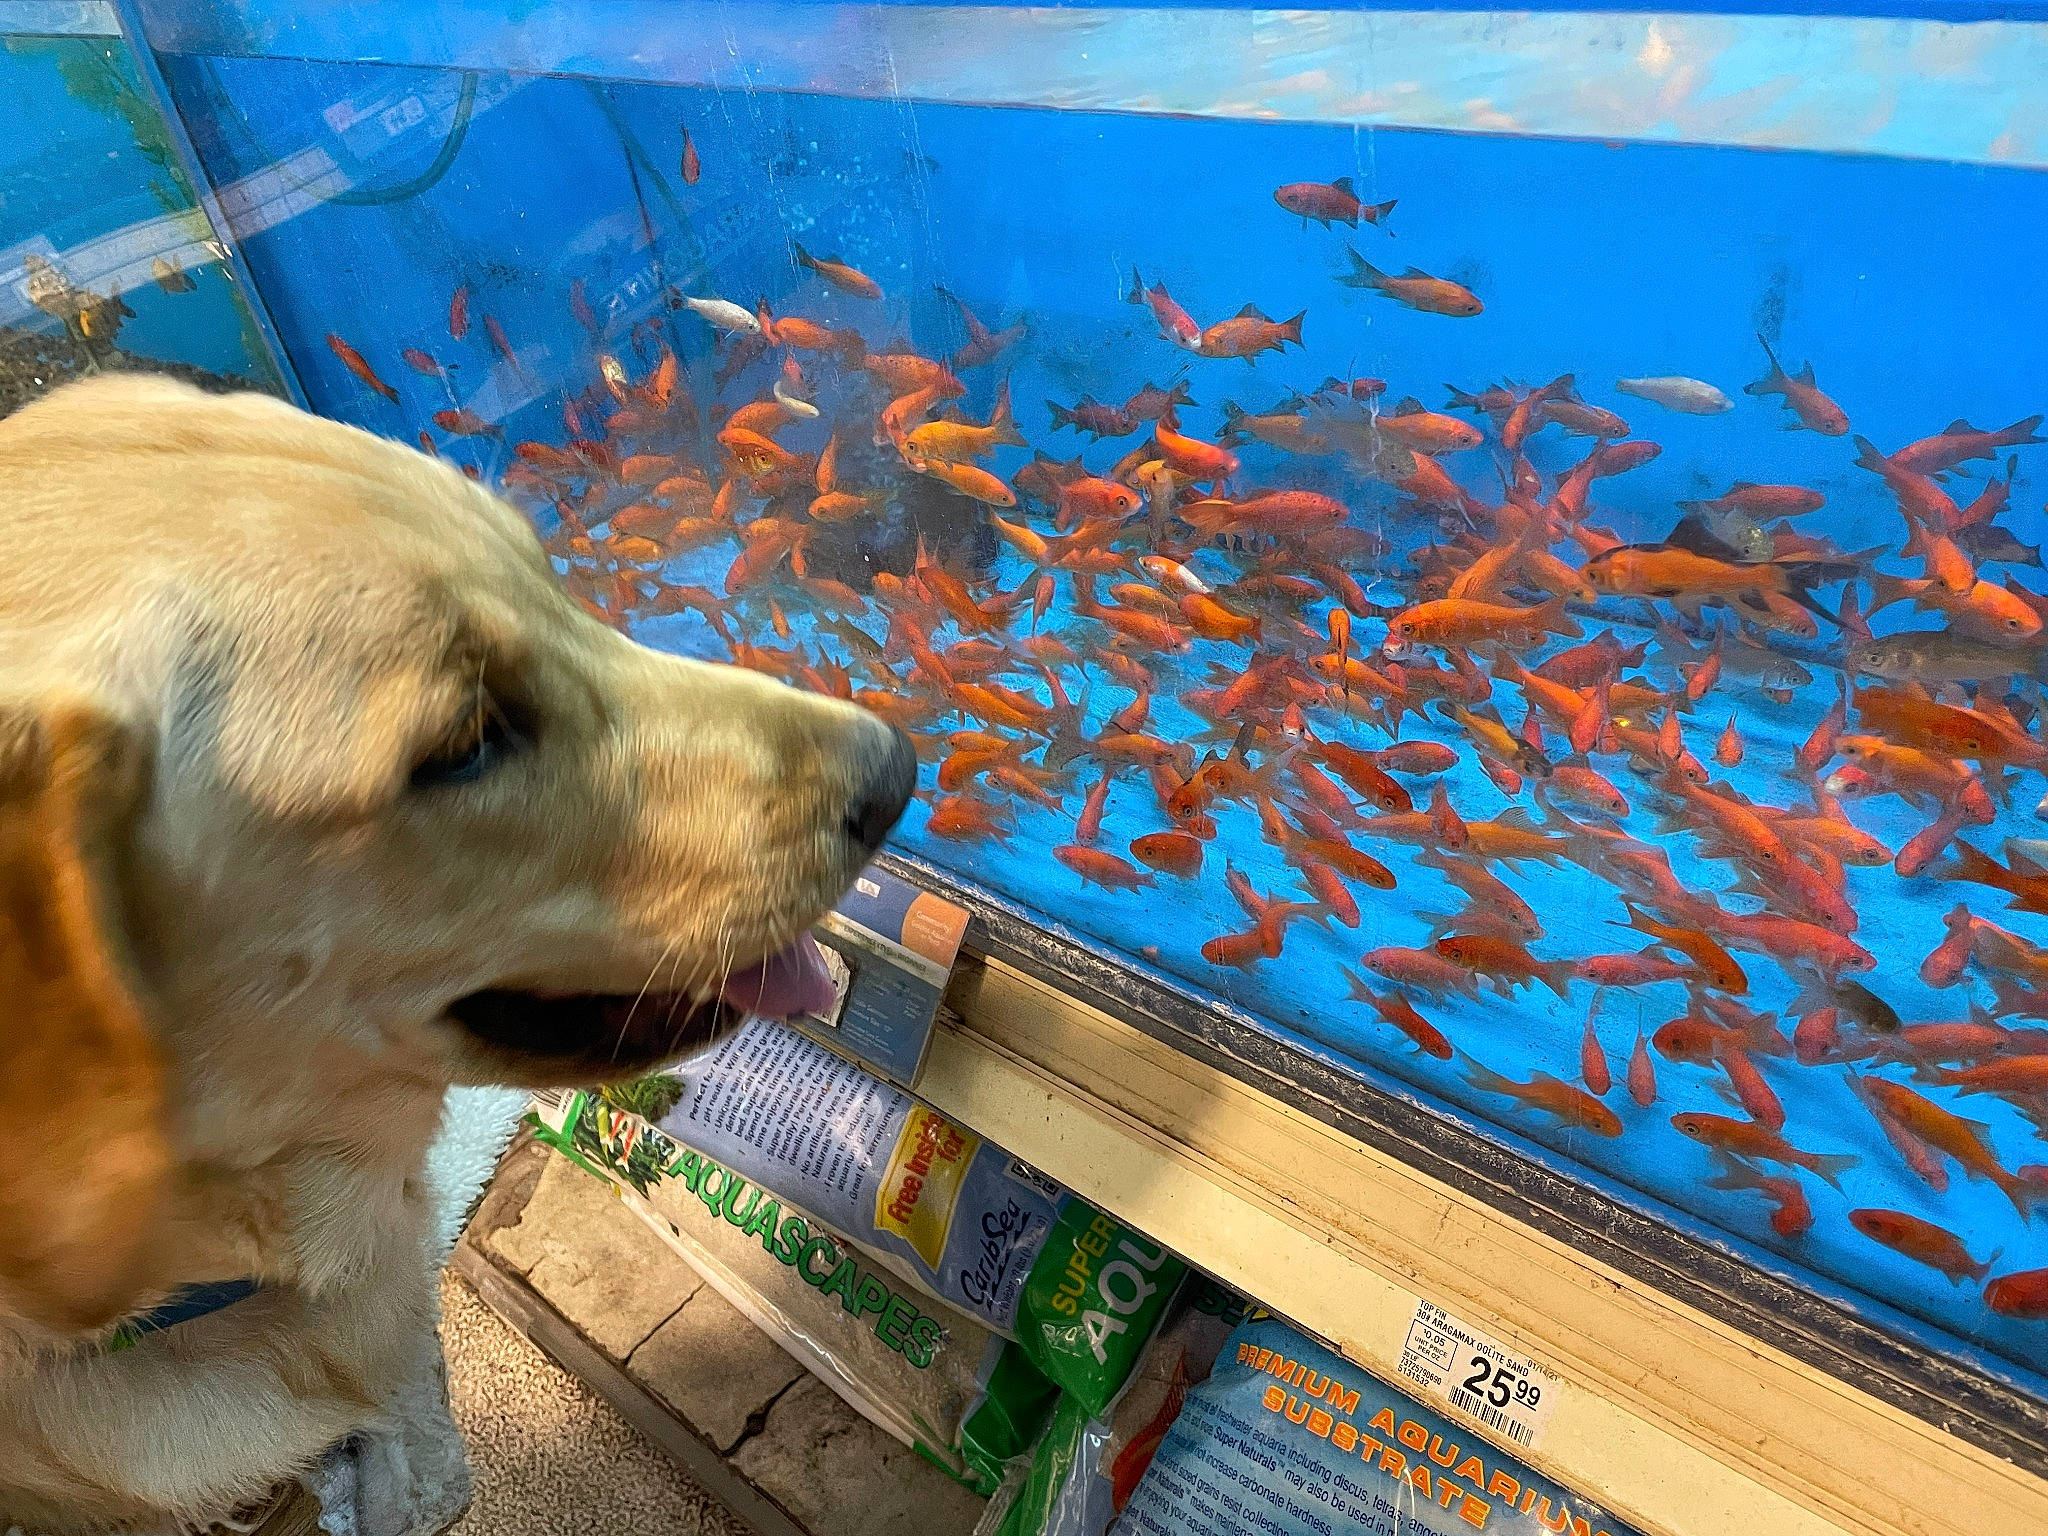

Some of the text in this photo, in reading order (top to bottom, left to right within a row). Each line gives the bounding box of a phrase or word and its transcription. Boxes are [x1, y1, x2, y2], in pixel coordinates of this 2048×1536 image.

[771, 1028, 785, 1046] and
[703, 1067, 715, 1083] for
[704, 1107, 712, 1123] pH
[725, 1052, 740, 1070] Will
[738, 1038, 751, 1053] not
[730, 1070, 745, 1093] sand
[744, 1045, 761, 1069] sized
[743, 1086, 760, 1116] Super
[744, 1110, 762, 1144] Spend
[756, 1092, 771, 1111] less
[768, 1070, 784, 1090] time
[753, 1127, 767, 1148] time
[764, 1085, 789, 1125] enjoying
[785, 1062, 800, 1085] your
[794, 1085, 816, 1120] Perfect
[811, 1071, 824, 1084] for
[764, 1127, 781, 1157] Super
[786, 1124, 810, 1168] dwelling
[806, 1111, 815, 1123] or
[800, 1160, 811, 1175] No
[807, 1118, 829, 1159] artificial
[825, 1096, 841, 1117] dyes
[839, 1083, 847, 1094] or
[837, 1140, 847, 1152] to
[937, 1128, 966, 1163] for
[849, 1173, 864, 1201] Great
[866, 1107, 895, 1158] terrariums
[888, 1176, 923, 1224] Free
[667, 1149, 943, 1369] AQUASCAPES
[961, 1197, 1021, 1306] CaribSea
[1051, 1215, 1118, 1315] SUPER
[1420, 1300, 1447, 1320] TOP FIN
[1414, 1336, 1448, 1358] UNIT PRICE
[1416, 1308, 1529, 1377] 30# ARAGAMAX OOLITE SAND
[1417, 1345, 1440, 1361] PER OZ
[1237, 1341, 1360, 1416] PREMIUM
[1397, 1364, 1430, 1388] 5131532
[1528, 1360, 1558, 1381] 01/14/21
[1214, 1426, 1238, 1449] Super
[1285, 1469, 1308, 1491] may
[1307, 1482, 1330, 1502] also
[1331, 1492, 1346, 1511] be
[1348, 1504, 1376, 1529] used
[1376, 1517, 1386, 1534] in
[1252, 1428, 1287, 1455] aquaria
[1287, 1446, 1332, 1484] including
[1334, 1471, 1369, 1505] discus,
[1373, 1494, 1404, 1526] tetras,
[1261, 1385, 1492, 1531] SUBSTRATE
[1190, 1495, 1215, 1519] makes
[1220, 1493, 1243, 1513] resist
[1238, 1473, 1285, 1508] carbonate
